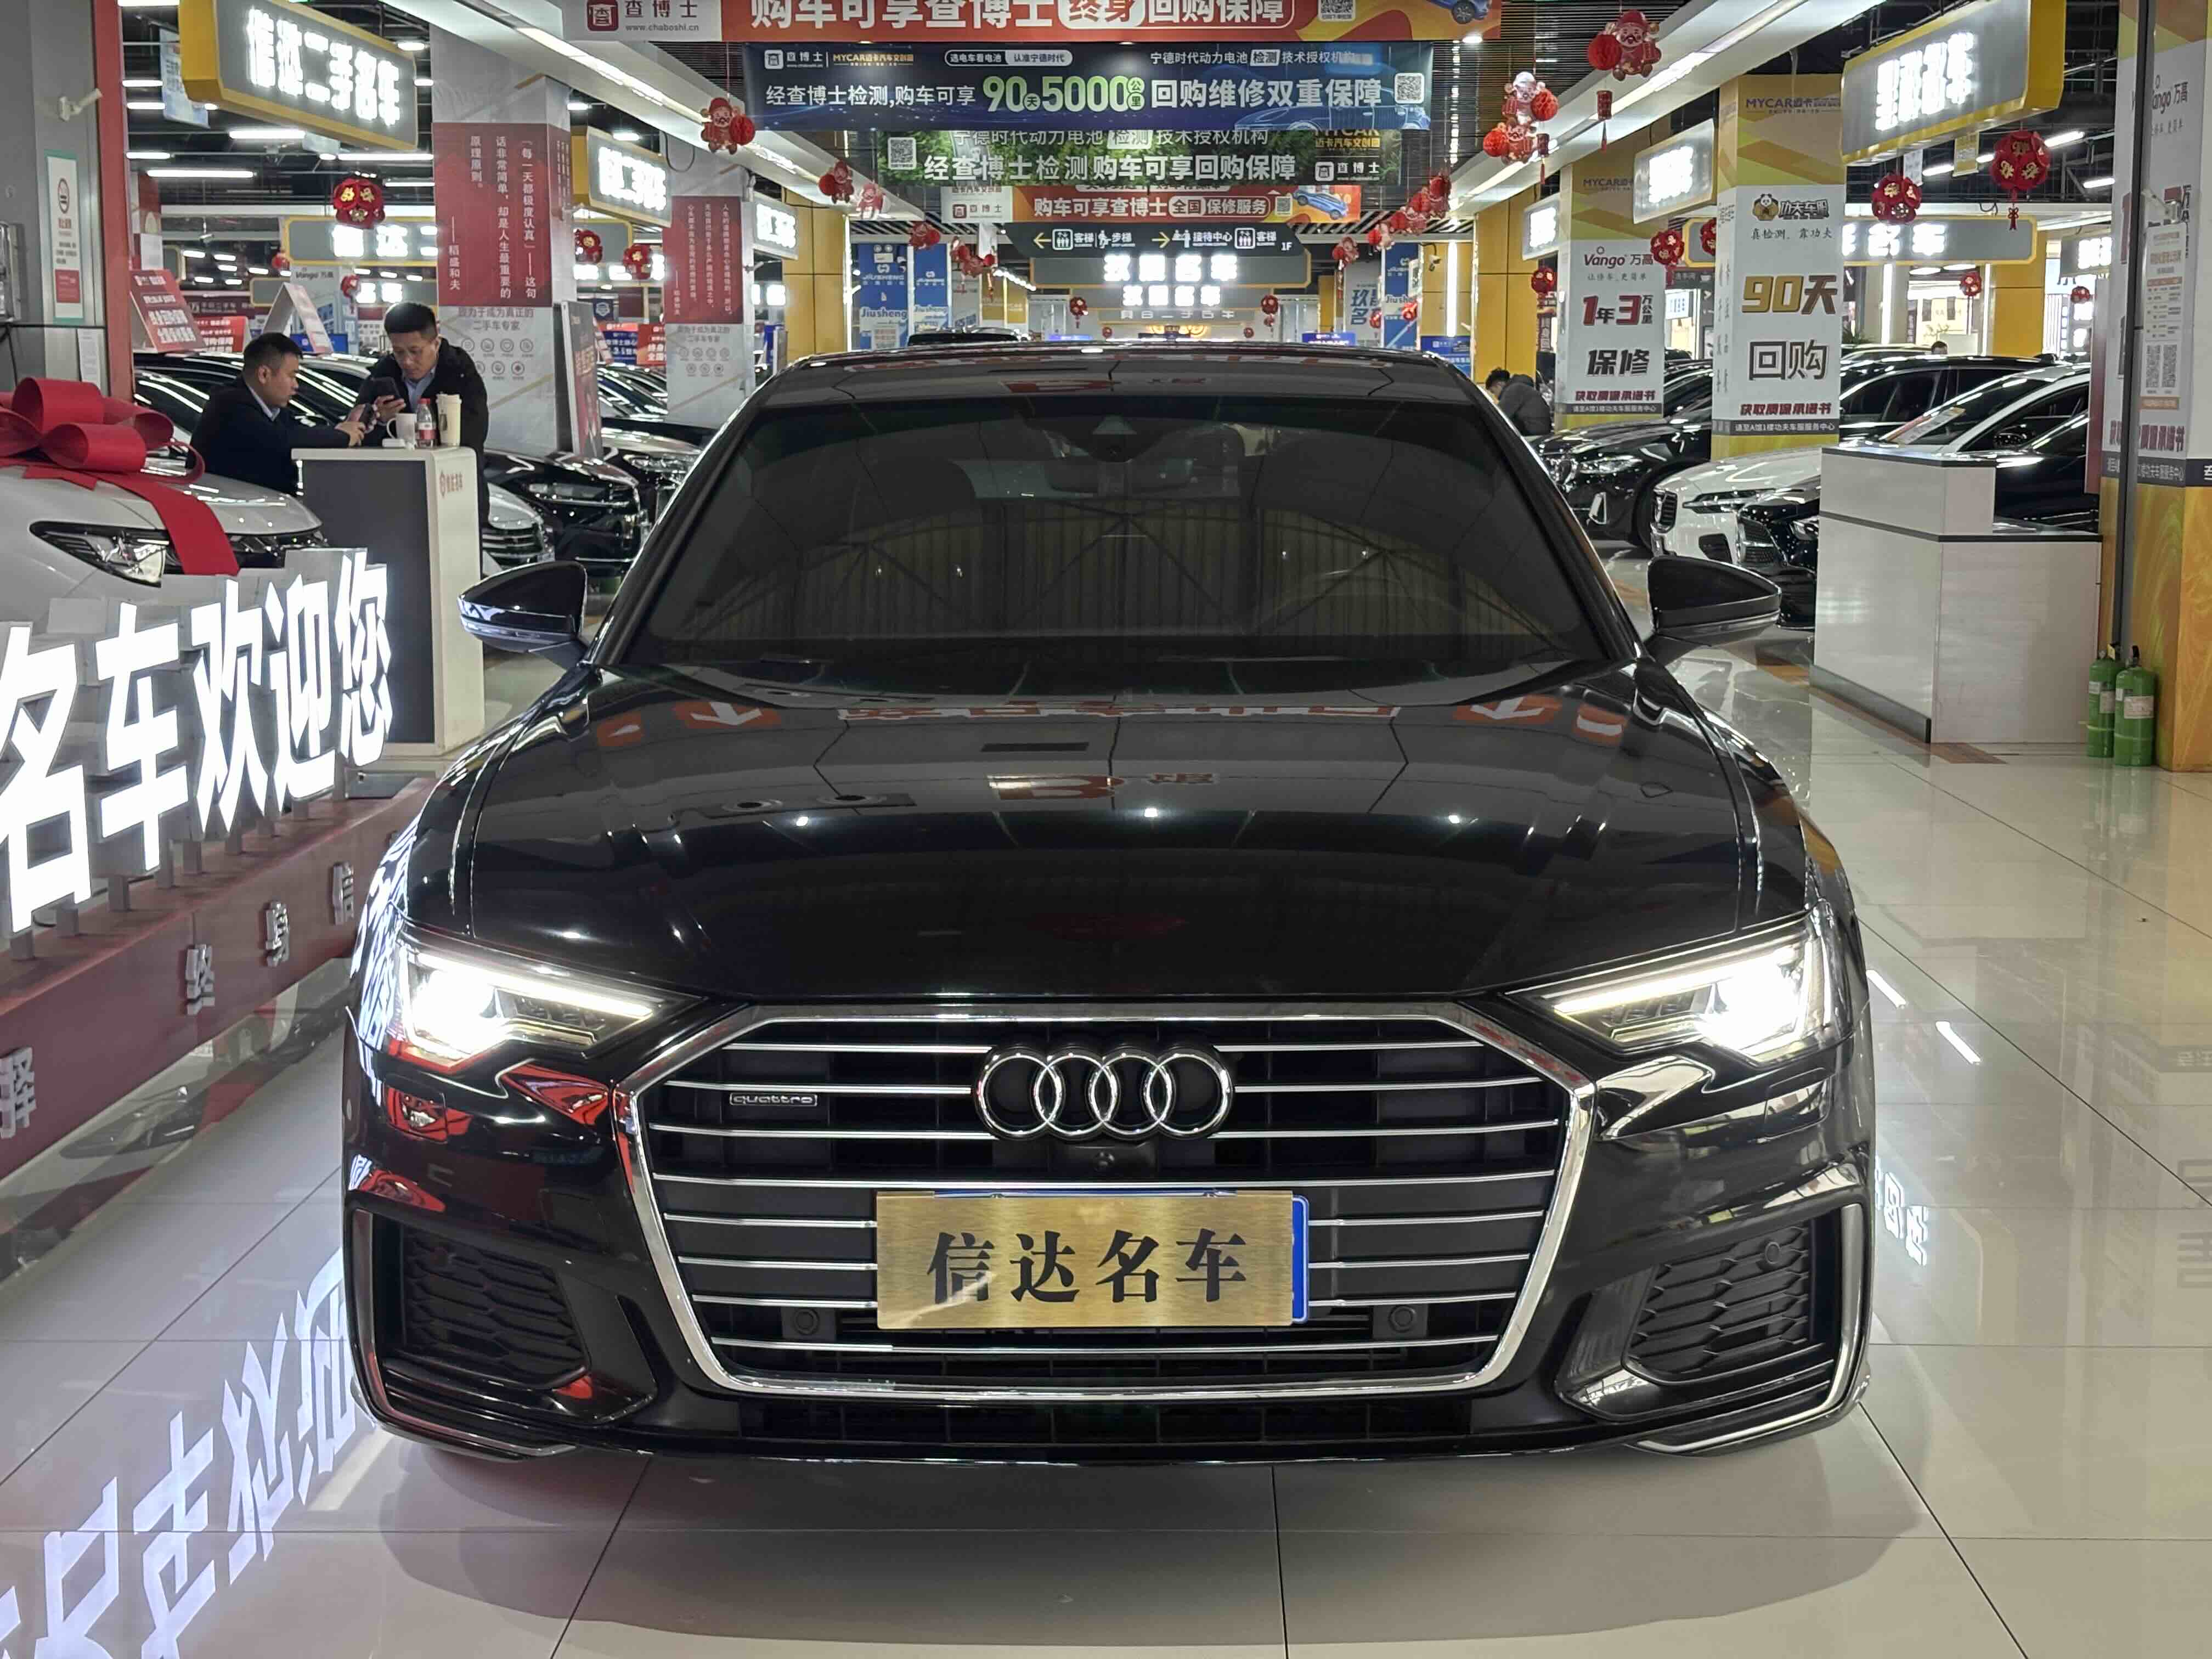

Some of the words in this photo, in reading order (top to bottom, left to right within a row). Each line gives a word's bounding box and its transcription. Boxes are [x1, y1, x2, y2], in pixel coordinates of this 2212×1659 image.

[624, 0, 698, 18] 查博士
[1074, 233, 1093, 243] 客梯
[1111, 233, 1132, 243] 步梯
[1192, 232, 1233, 242] 接待中心
[1256, 232, 1277, 242] 客梯
[1281, 242, 1293, 251] 1F
[1584, 254, 1626, 269] Vango
[1629, 254, 1653, 266] 万高
[1742, 275, 1838, 315] 90天
[1587, 348, 1650, 375] 保修
[1748, 339, 1829, 381] 回购
[0, 552, 394, 934] 名车欢迎您
[733, 1094, 813, 1104] quattro
[927, 1228, 1247, 1304] 信达名车
